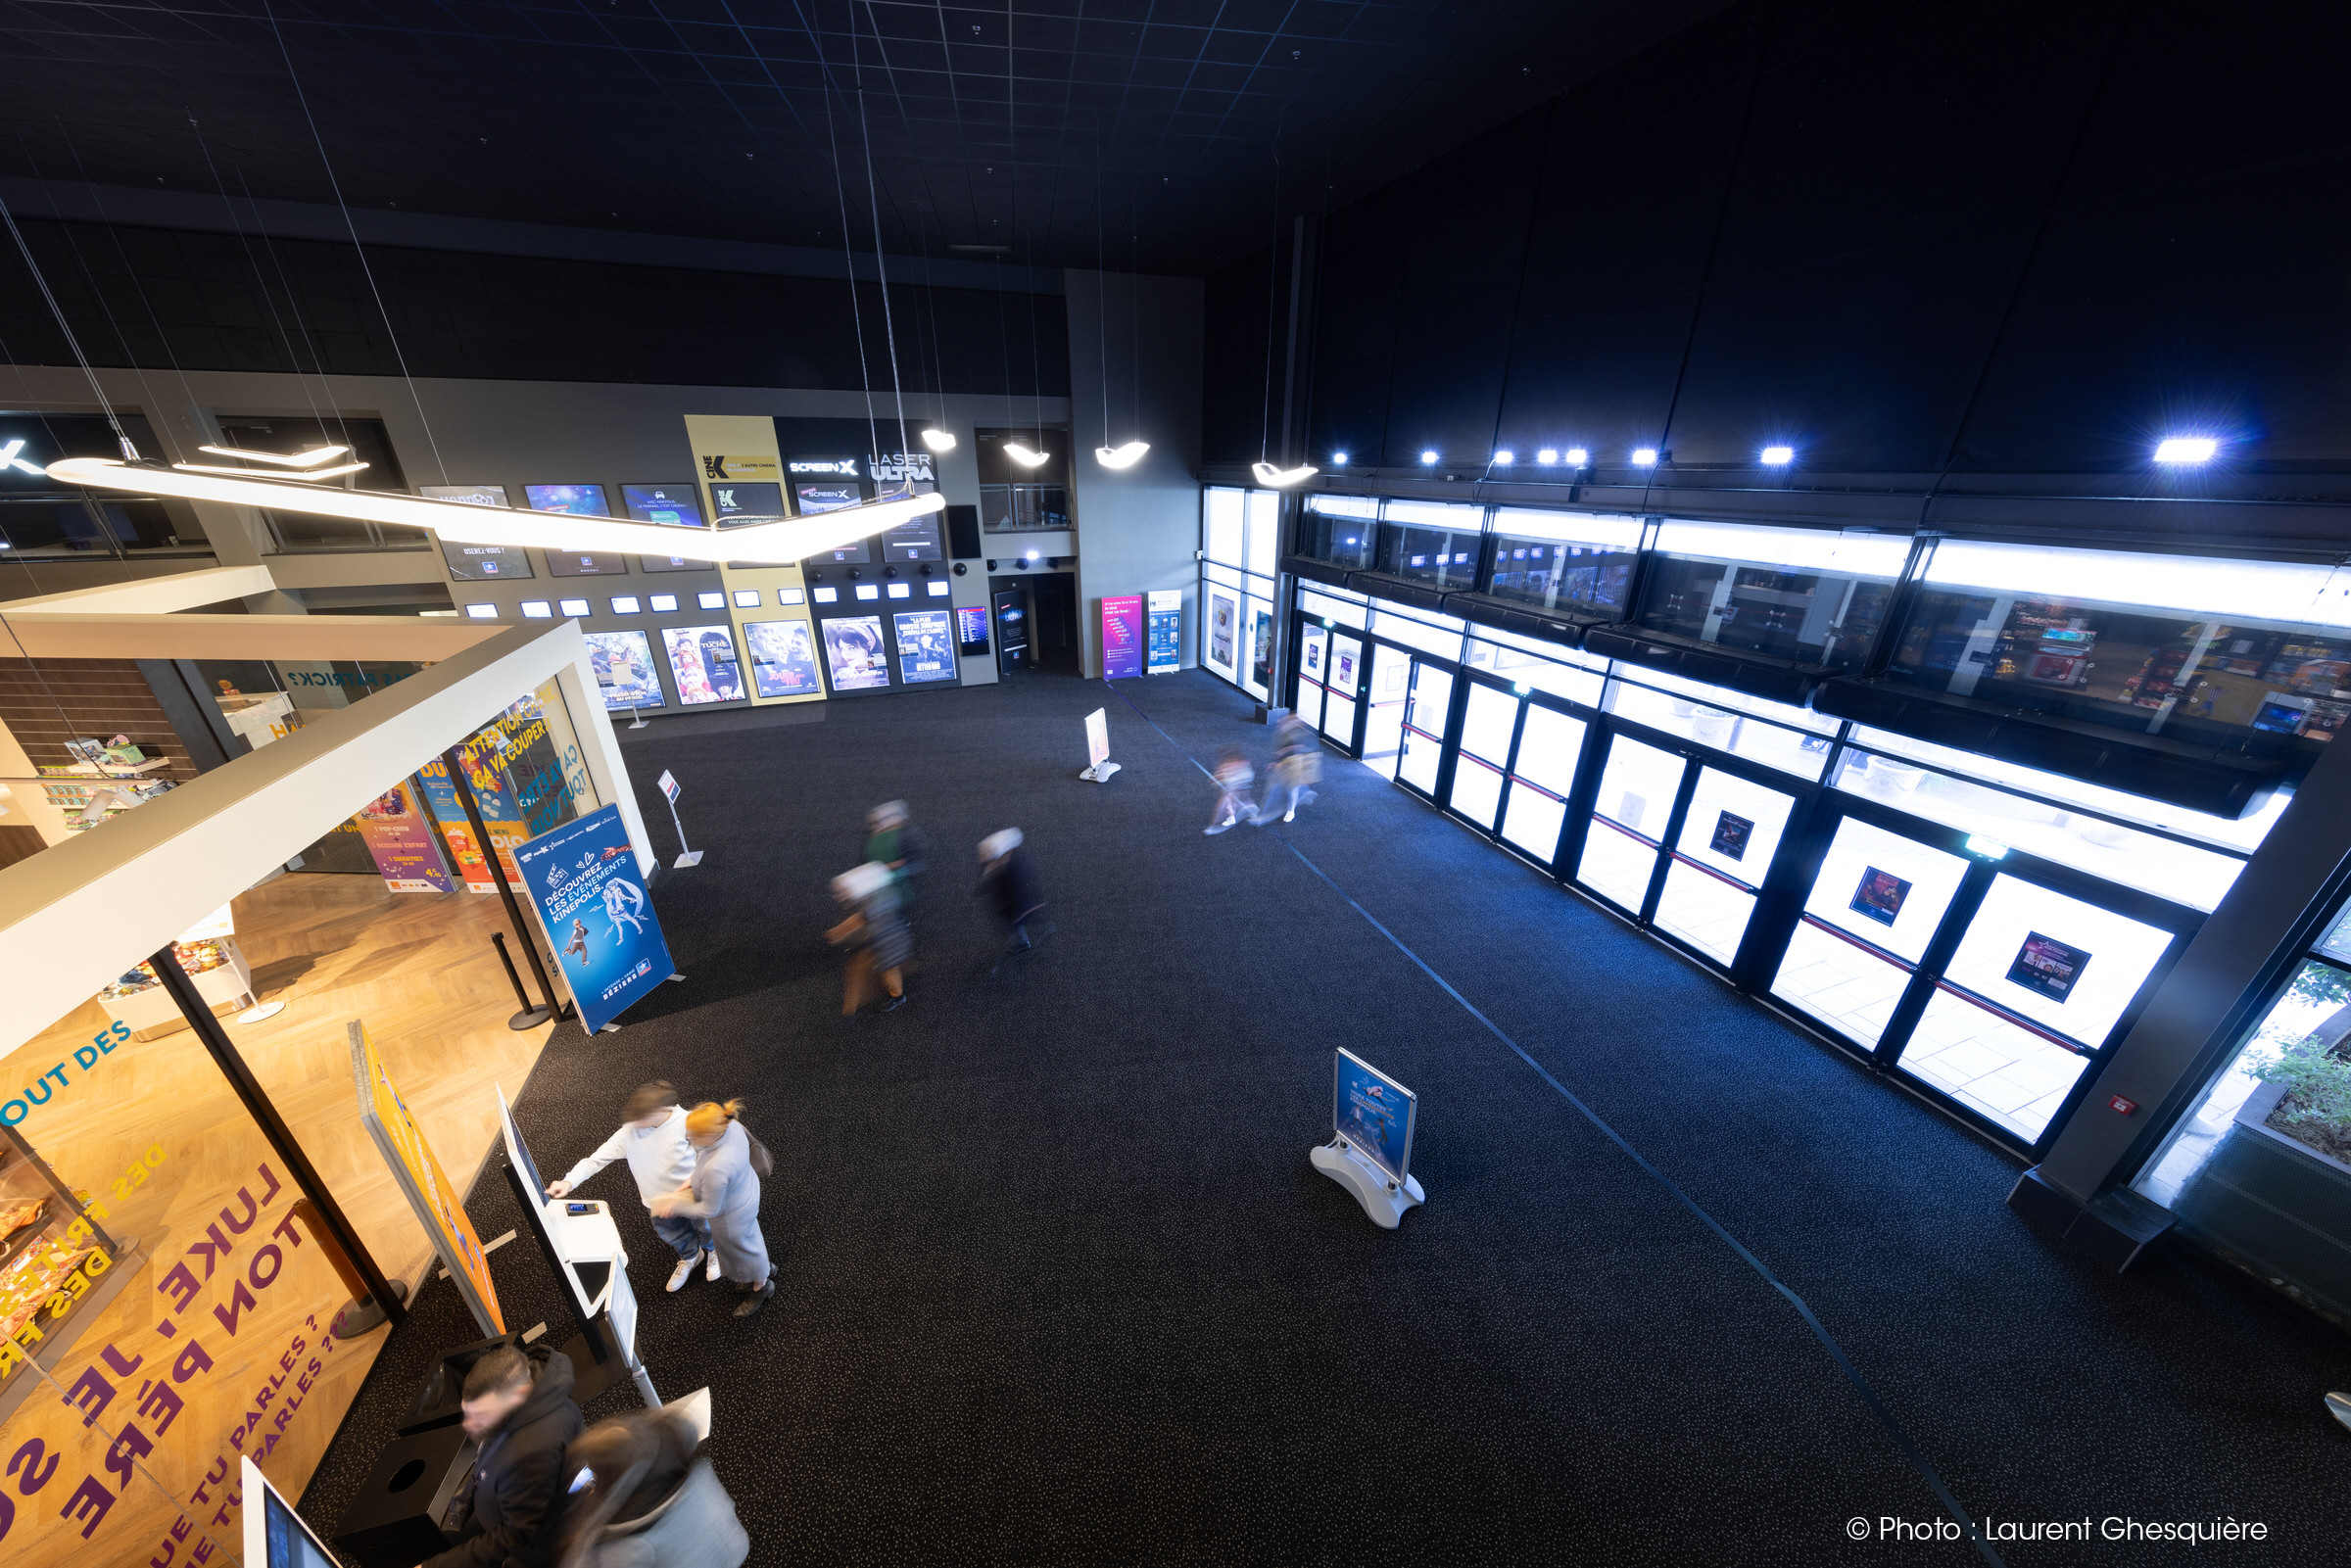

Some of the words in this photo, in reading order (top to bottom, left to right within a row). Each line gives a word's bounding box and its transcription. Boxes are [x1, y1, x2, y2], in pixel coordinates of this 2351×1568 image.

[868, 453, 931, 466] LASER
[870, 465, 935, 480] ULTRA
[464, 709, 524, 765] ATTENTION
[489, 751, 508, 774] VA
[545, 861, 603, 907] DÉCOUVREZ
[552, 884, 605, 925] KINEPOLIS.
[549, 896, 568, 917] LES
[602, 973, 638, 1001] BÉZIERS
[72, 1020, 132, 1071] DES
[189, 1454, 228, 1505] TU
[229, 1335, 307, 1451] PARLES
[306, 1313, 318, 1332] ?
[251, 1356, 322, 1470] PARLES
